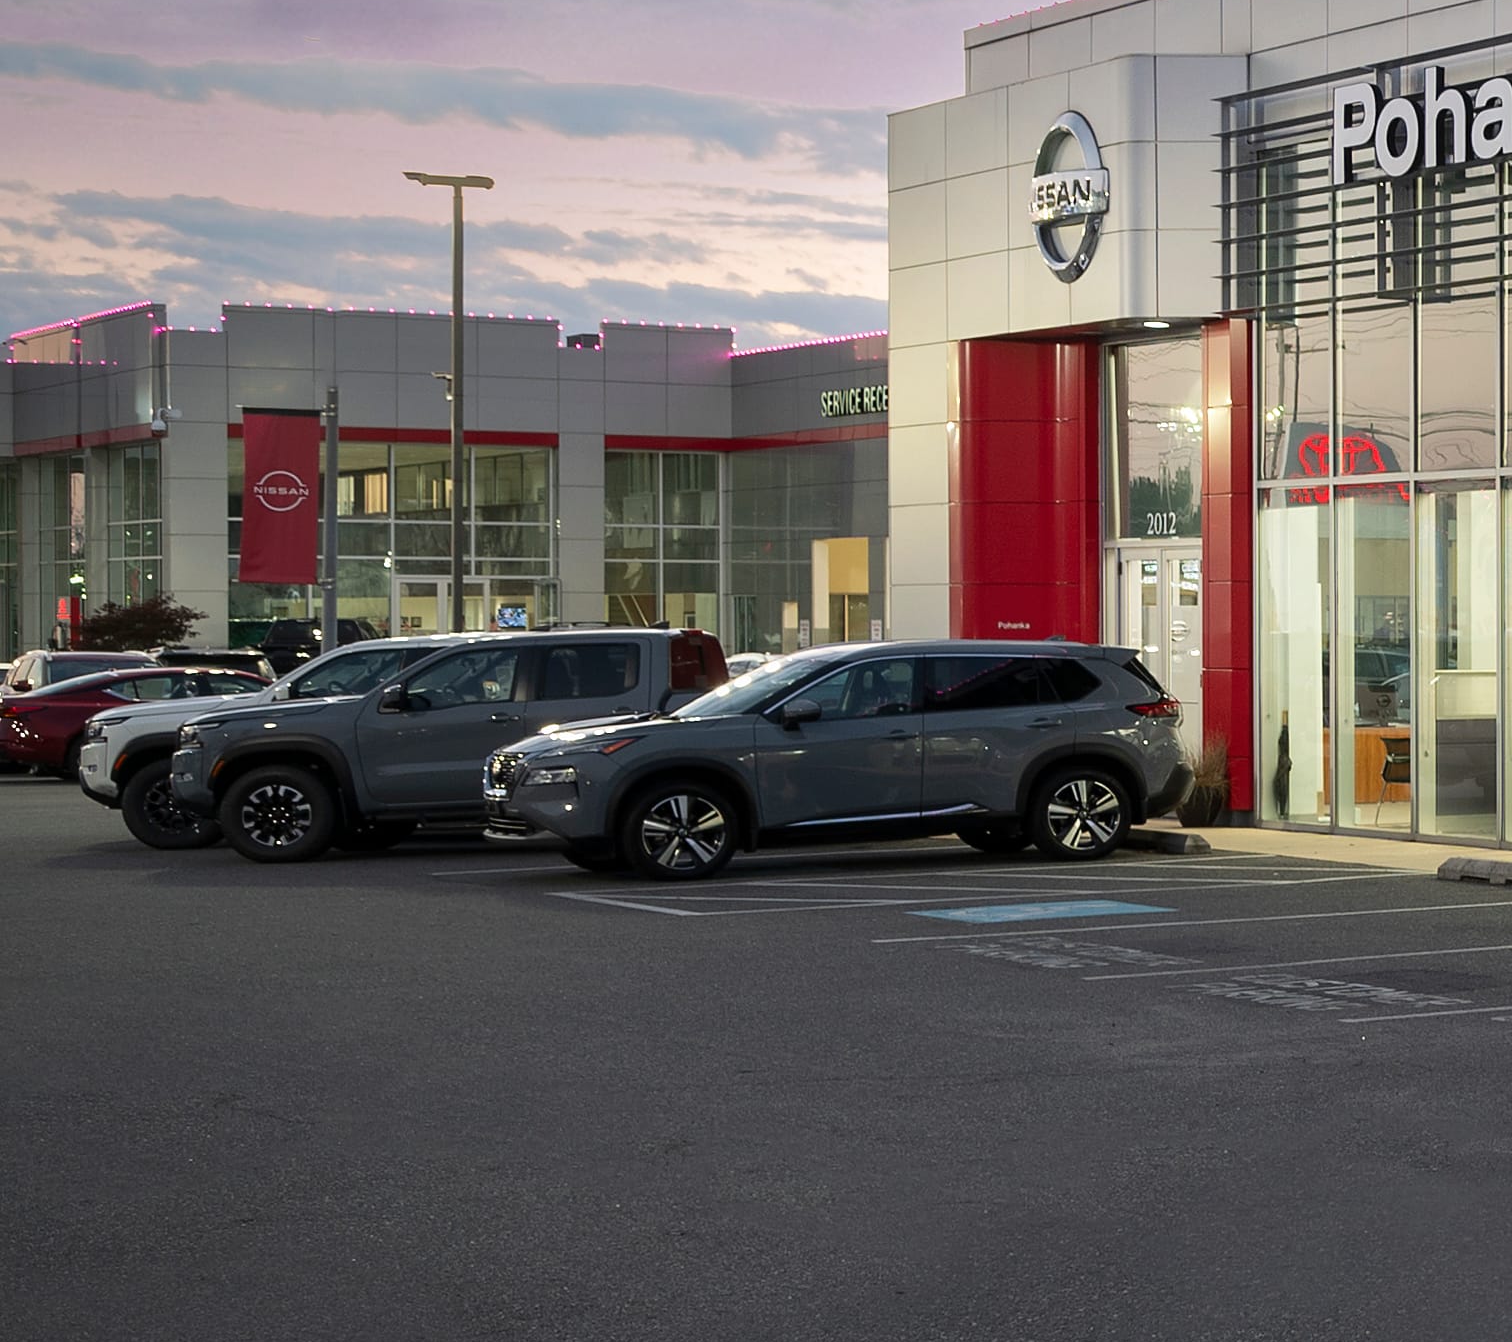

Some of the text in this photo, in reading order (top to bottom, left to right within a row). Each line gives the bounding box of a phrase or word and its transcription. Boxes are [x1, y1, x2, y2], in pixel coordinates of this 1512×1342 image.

[821, 390, 861, 417] SERVICE
[253, 485, 309, 496] NISSAN
[1147, 513, 1176, 535] 2012
